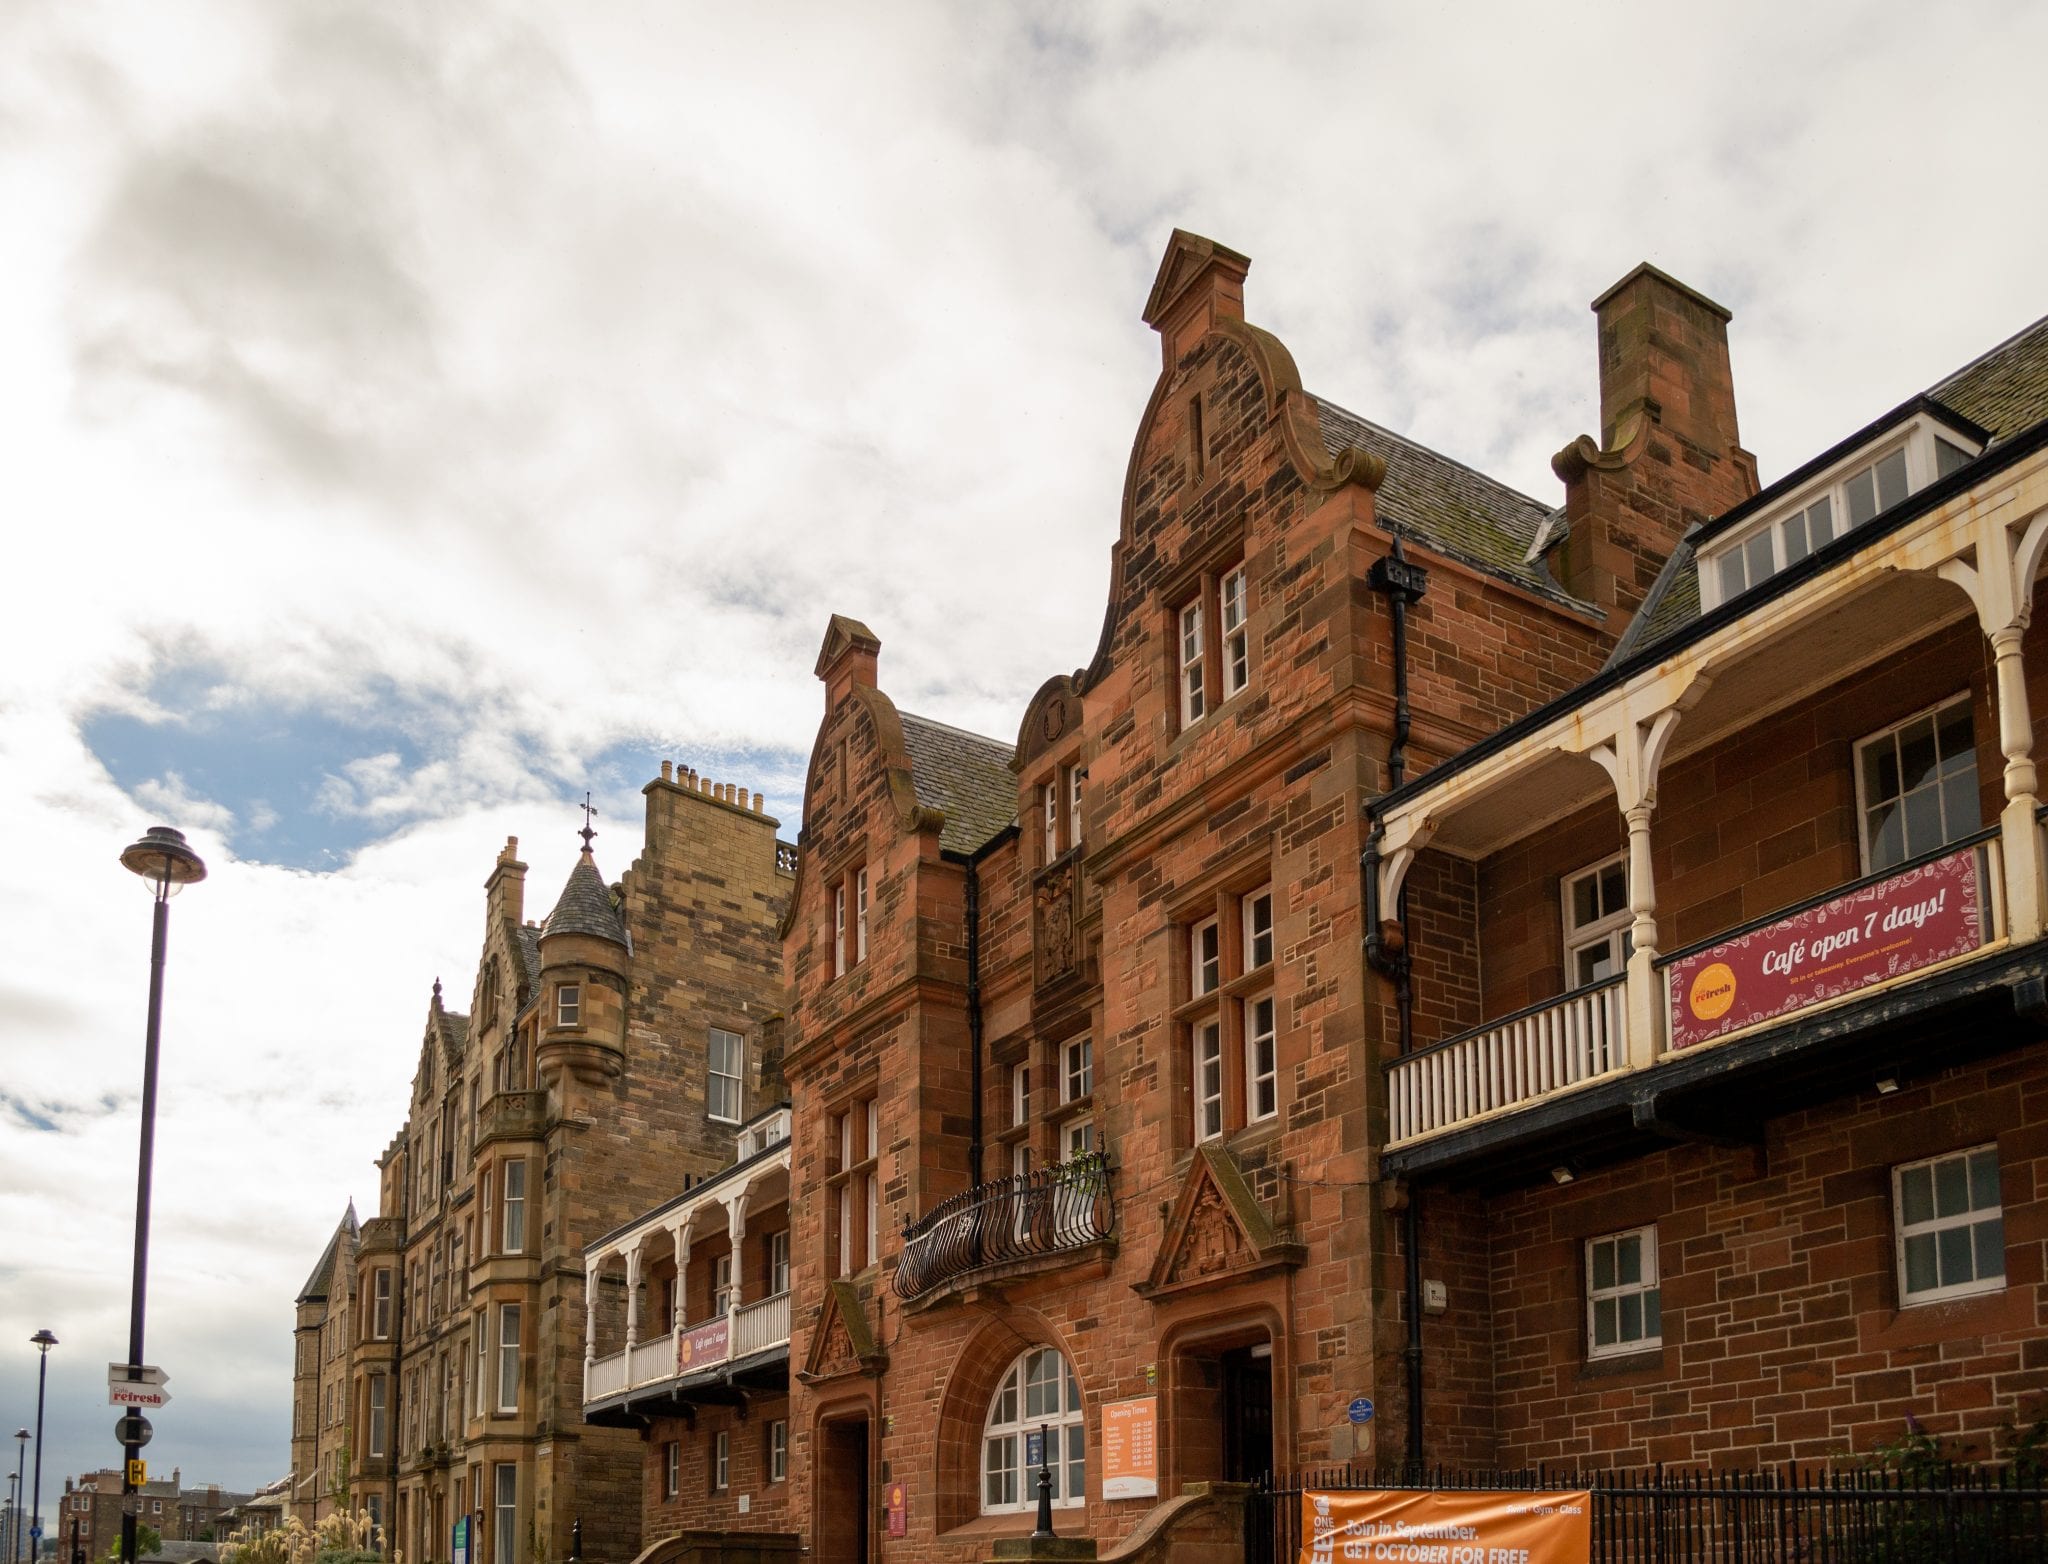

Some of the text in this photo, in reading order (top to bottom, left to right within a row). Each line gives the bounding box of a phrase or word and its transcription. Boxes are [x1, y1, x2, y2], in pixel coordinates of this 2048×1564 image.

[1762, 888, 1946, 976] Café open 7 days!
[1799, 974, 1806, 982] in
[1807, 971, 1814, 979] or
[1845, 949, 1880, 965] Everyone's
[1880, 937, 1913, 953] welcome!
[1695, 984, 1731, 1003] refresh
[113, 1391, 161, 1404] refresh
[1110, 1406, 1148, 1420] Opening Times
[132, 1462, 145, 1482] H
[1506, 1504, 1582, 1516] Swim Gym Class
[1313, 1516, 1335, 1528] ONE
[1343, 1519, 1480, 1542] Join in September.
[1343, 1541, 1529, 1564] GET OCTOBER FOR FREE
